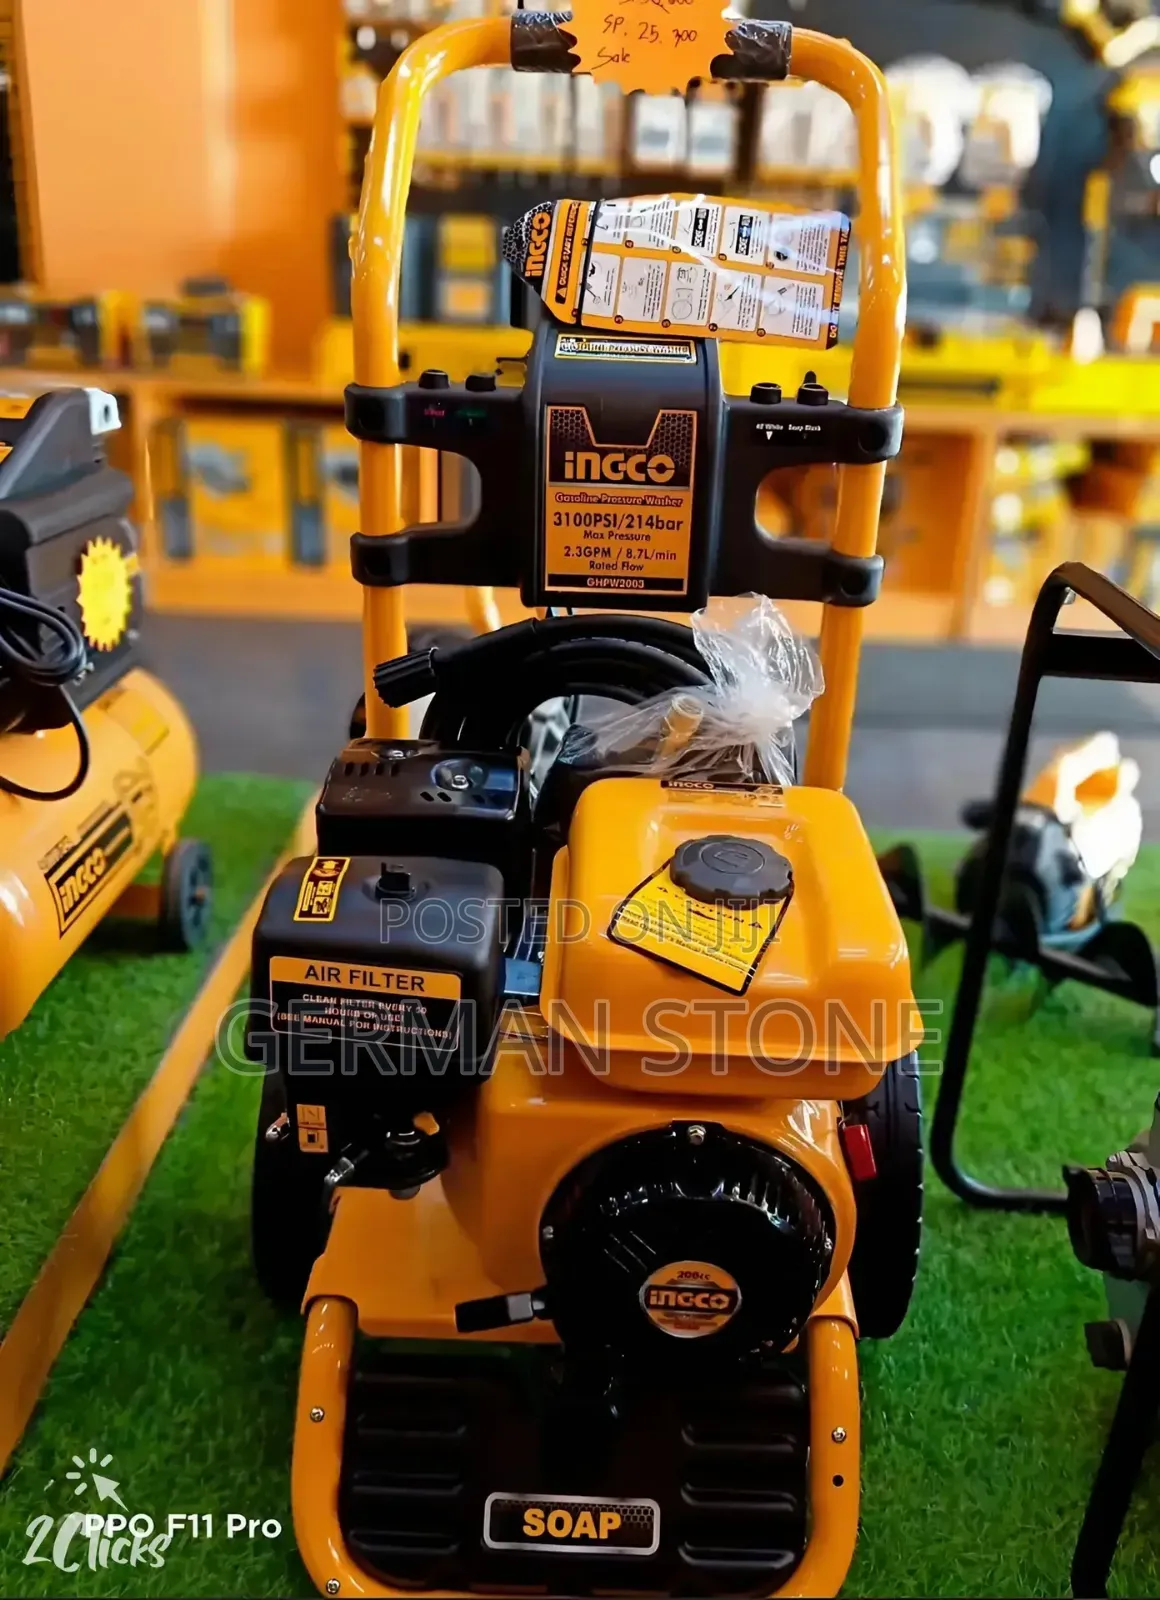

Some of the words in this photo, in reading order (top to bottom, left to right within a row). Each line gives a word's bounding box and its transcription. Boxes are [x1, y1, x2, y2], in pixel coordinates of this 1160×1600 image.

[555, 492, 600, 504] Gasoline
[600, 493, 645, 506] Pressure
[644, 495, 684, 508] Washer
[553, 511, 684, 532] 3100PSI/214bar
[583, 529, 604, 540] Max
[607, 530, 651, 542] Pressure
[563, 545, 612, 559] 2.3GPM
[625, 548, 677, 561] 8.7L/min
[589, 560, 618, 571] Rated
[621, 561, 645, 572] Flow
[586, 577, 645, 589] GHPW2003
[304, 964, 341, 984] AIR
[349, 969, 425, 992] FILTER
[302, 993, 337, 1005] CLEAN
[340, 998, 375, 1009] FILTER
[303, 1015, 346, 1027] MANUAL
[349, 1020, 371, 1030] FOR
[522, 1507, 622, 1540] SOAP
